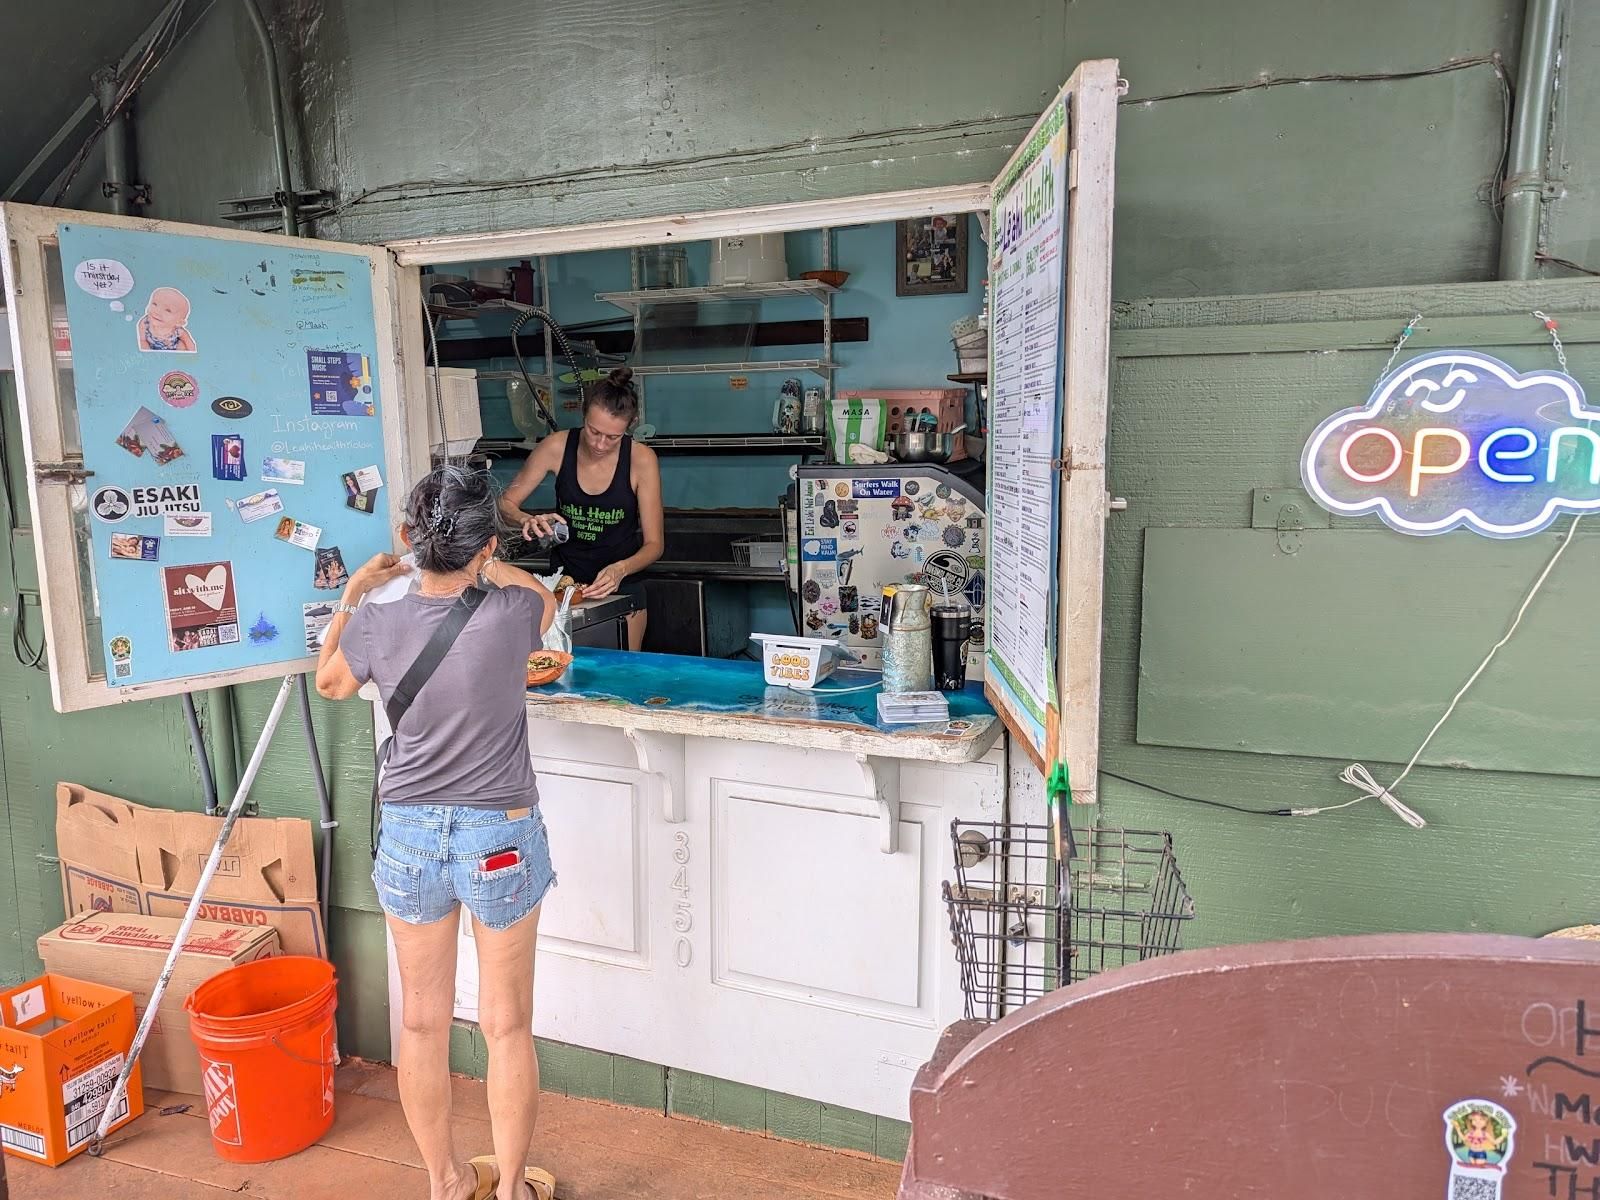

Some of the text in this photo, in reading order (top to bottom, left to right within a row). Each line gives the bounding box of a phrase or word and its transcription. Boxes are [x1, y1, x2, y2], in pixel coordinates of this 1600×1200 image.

[311, 356, 327, 364] SMALL
[842, 408, 870, 416] MASA
[271, 414, 358, 440] Instagram
[1339, 427, 1600, 497] open
[854, 480, 899, 489] Surfers Walk
[133, 485, 199, 504] ESAKI
[860, 488, 894, 497] On Water
[136, 505, 159, 517] JIU
[587, 506, 625, 520] Health
[772, 653, 811, 669] GOOD
[770, 665, 811, 681] VIBES
[82, 1081, 113, 1104] 429970
